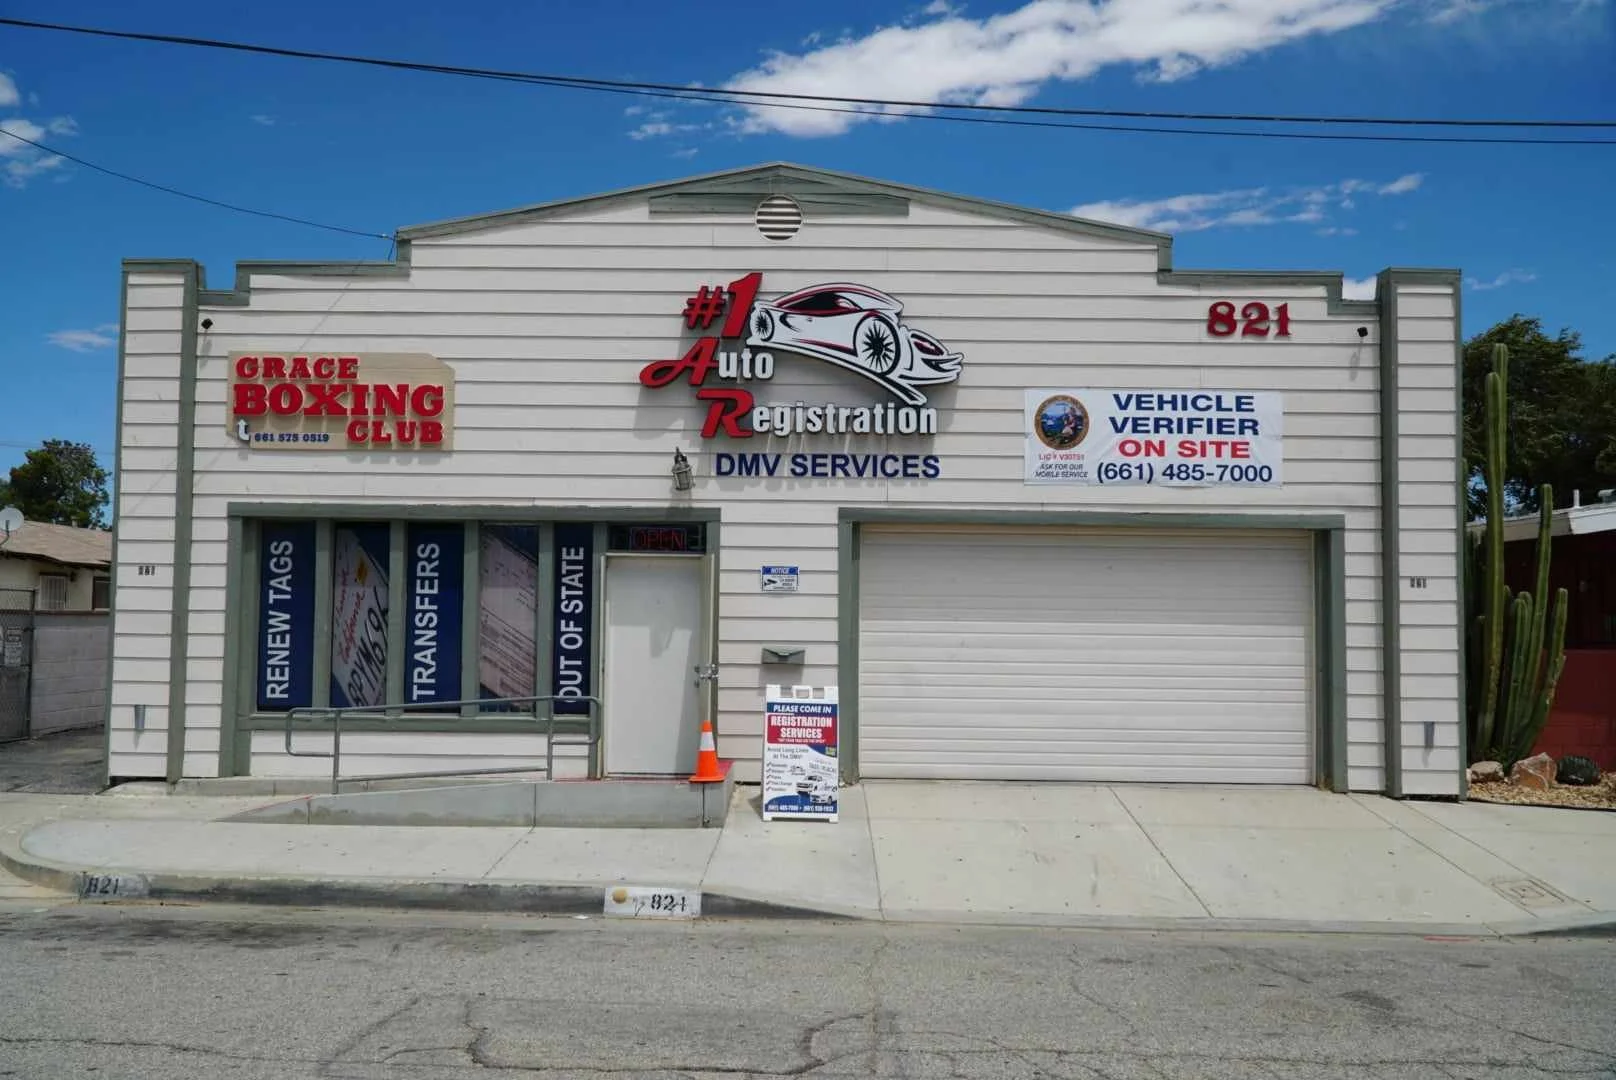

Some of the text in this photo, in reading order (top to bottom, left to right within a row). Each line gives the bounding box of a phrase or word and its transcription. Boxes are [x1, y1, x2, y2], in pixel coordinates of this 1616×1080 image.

[682, 271, 763, 338] #1
[1207, 301, 1291, 337] 821
[236, 357, 359, 379] GRACE
[639, 336, 774, 389] Auto
[232, 383, 444, 416] BOXING
[1112, 393, 1255, 413] VEHICLE
[696, 387, 938, 438] Registration
[347, 420, 443, 443] CLUB
[1108, 416, 1260, 436] VERIFIER
[254, 433, 274, 443] 661
[1118, 439, 1250, 459] ON SITE
[715, 453, 941, 479] DMV SERVICES
[1097, 462, 1273, 484] (661) 485-7000
[266, 539, 293, 699] RENEW TAGS
[412, 542, 440, 701] TRANSFERS
[558, 545, 585, 703] OUT OF STATE
[773, 704, 799, 713] PLEASE
[800, 705, 822, 713] COME
[771, 716, 832, 728] REGISTRATION
[780, 727, 823, 739] SERVICES
